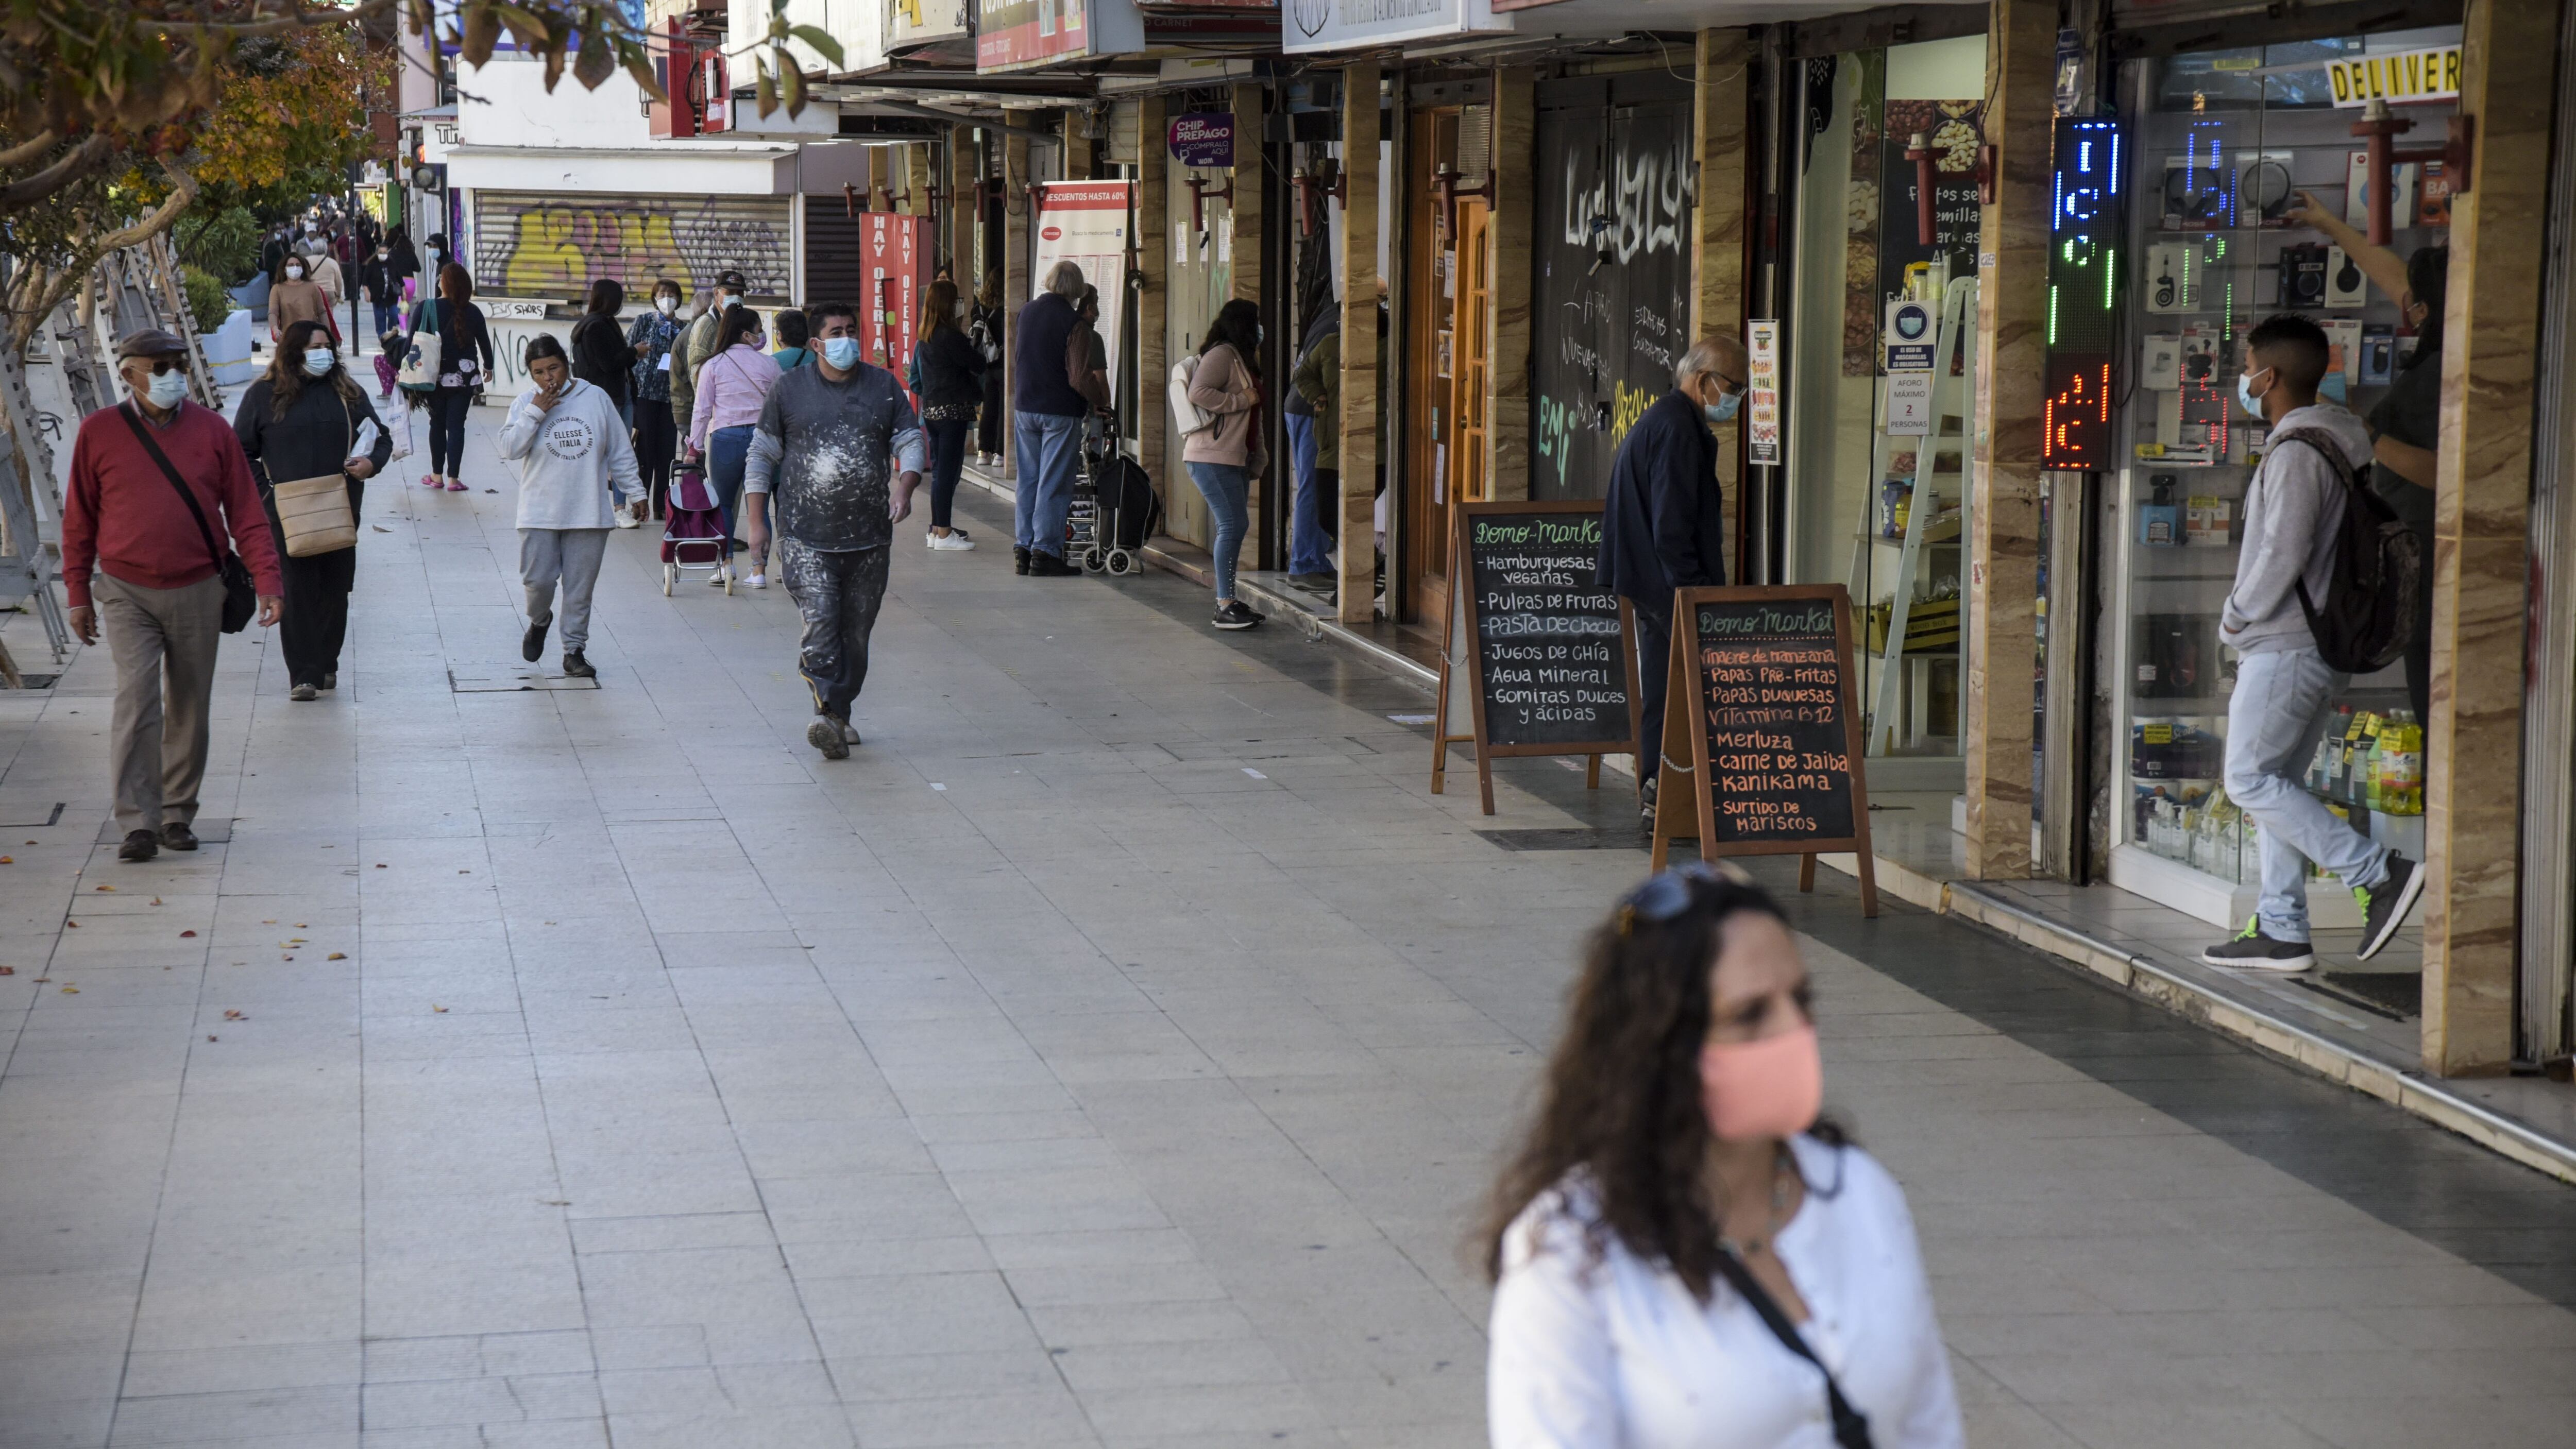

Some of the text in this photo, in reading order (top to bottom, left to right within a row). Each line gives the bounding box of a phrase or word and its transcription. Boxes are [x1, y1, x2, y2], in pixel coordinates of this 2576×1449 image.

[2332, 50, 2459, 102] DELIVER
[1177, 120, 1204, 131] CHIP
[1177, 127, 1229, 141] PREPAGO
[1189, 141, 1229, 150] CÓMPRALO
[1112, 192, 1126, 200] 60%
[1909, 186, 1978, 204] Ftos se
[1937, 207, 1980, 224] emilla
[873, 216, 885, 257] HAY
[1906, 404, 1912, 414] 2
[554, 429, 583, 439] ELLESSE
[559, 439, 581, 448] ITALIA
